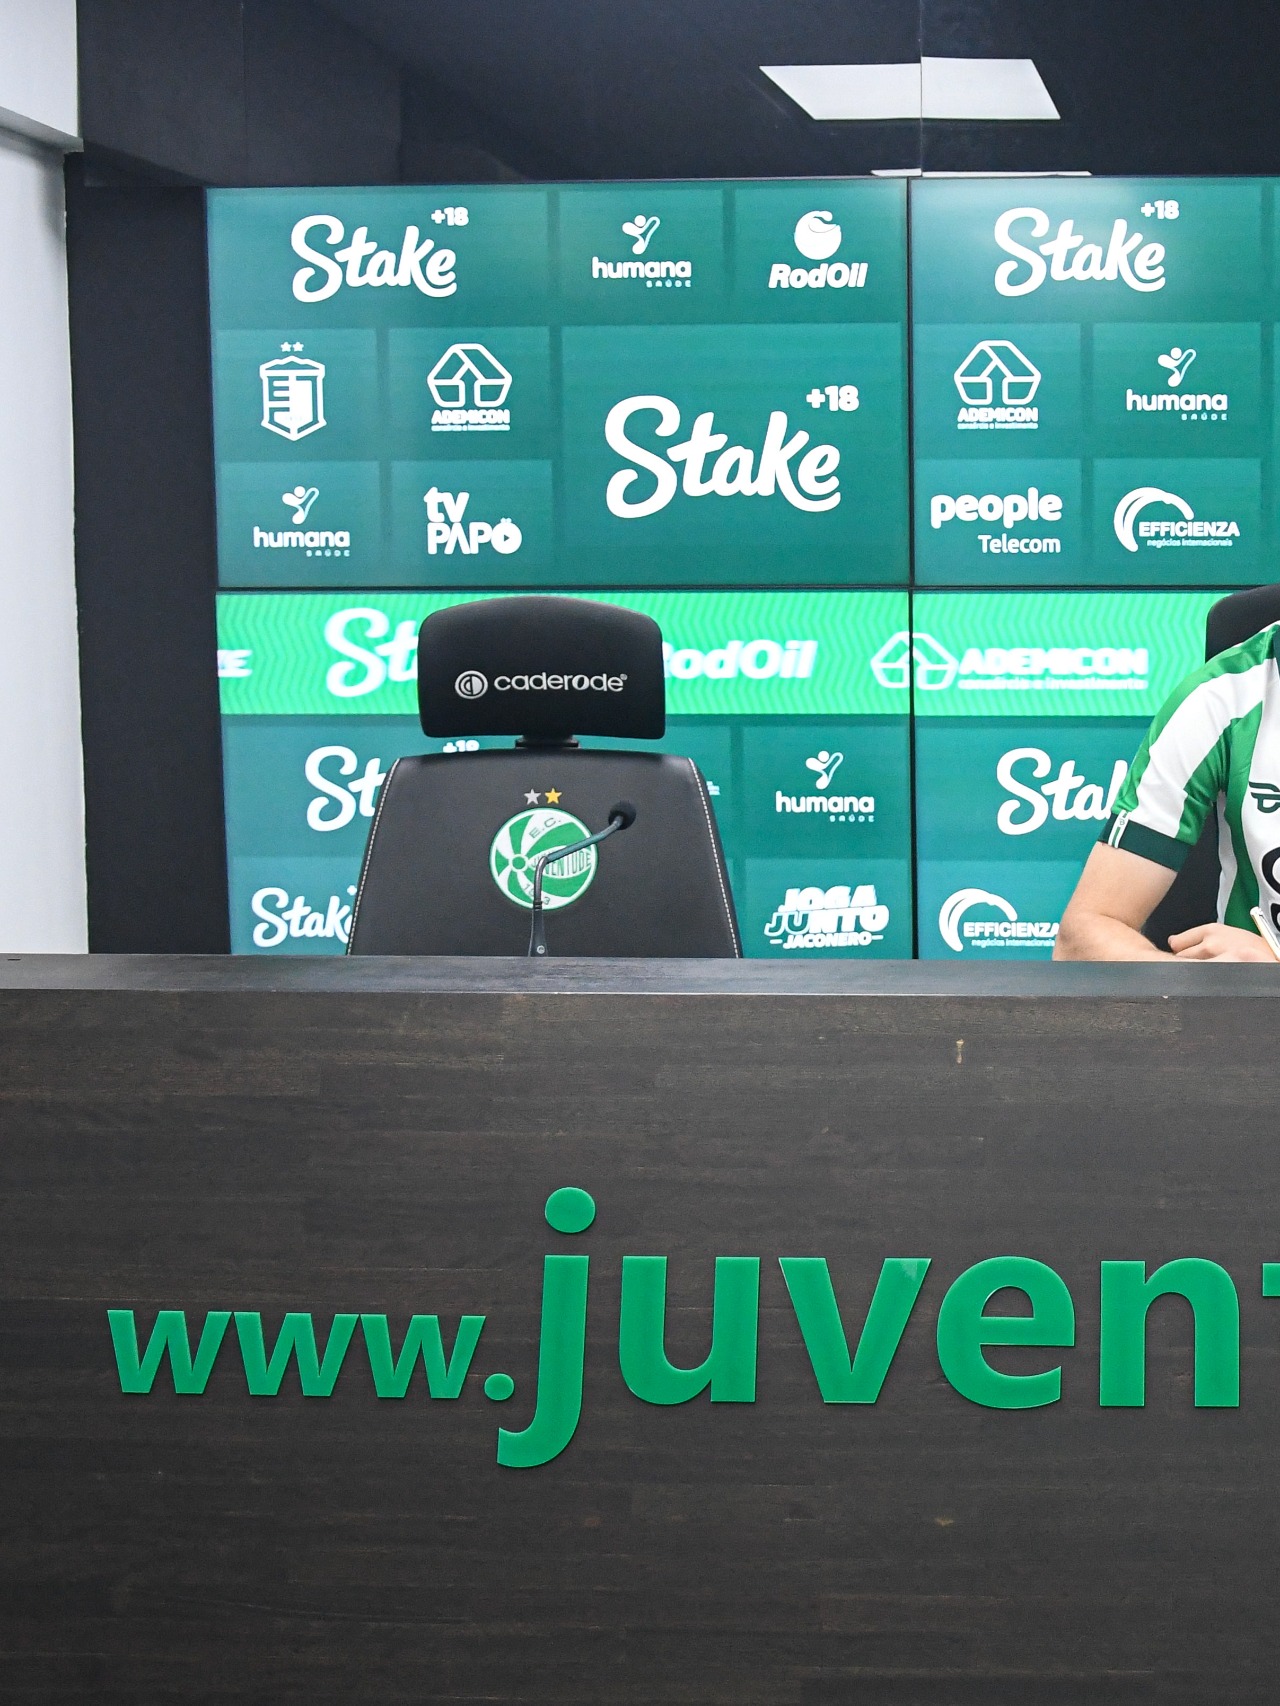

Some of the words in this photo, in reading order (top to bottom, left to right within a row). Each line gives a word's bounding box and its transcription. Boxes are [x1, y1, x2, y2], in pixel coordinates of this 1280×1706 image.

[431, 206, 469, 226] +18
[1140, 199, 1180, 219] +18
[291, 214, 457, 303] Stake
[994, 207, 1166, 297] Stake
[592, 256, 692, 279] humana
[768, 262, 868, 289] RodOil
[806, 385, 860, 412] +18
[1126, 388, 1228, 411] humana
[431, 409, 511, 425] ADEMICON
[957, 407, 1039, 422] ADEMICON
[605, 395, 841, 519] Stake
[423, 486, 470, 522] tv
[930, 486, 1063, 529] people
[253, 526, 351, 548] humana
[1138, 521, 1241, 537] EFFICIENZA
[978, 534, 1061, 553] Telecom
[958, 648, 1149, 675] ADEMICON
[775, 790, 875, 813] humana
[251, 887, 352, 947] Stak
